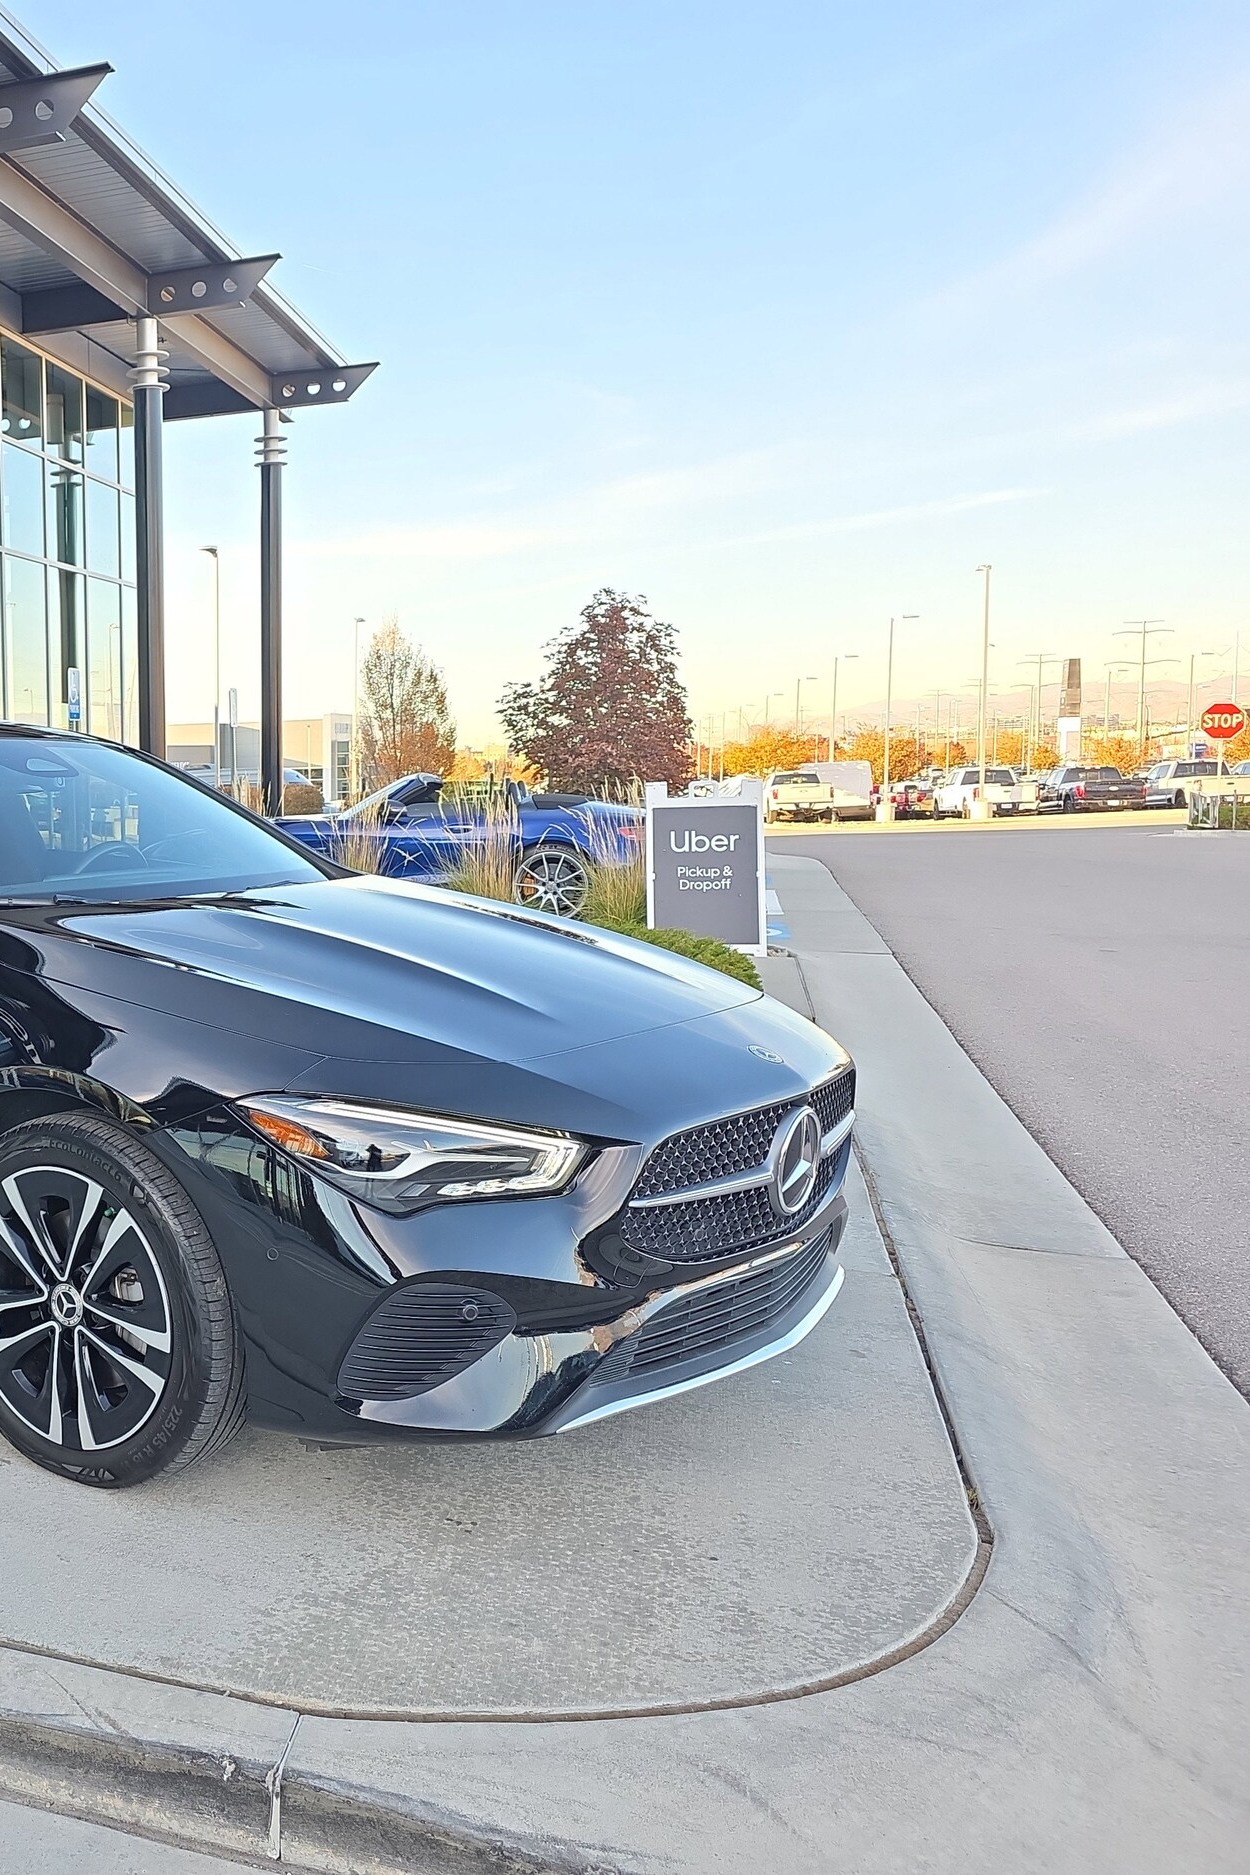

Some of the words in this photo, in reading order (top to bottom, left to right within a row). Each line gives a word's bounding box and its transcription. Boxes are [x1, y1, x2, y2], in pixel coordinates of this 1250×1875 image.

[1202, 713, 1243, 729] STOP
[670, 830, 740, 853] Uber
[677, 866, 721, 879] Pickup
[722, 865, 733, 877] &
[679, 878, 732, 892] Dropoff
[152, 1405, 182, 1449] 225/45
